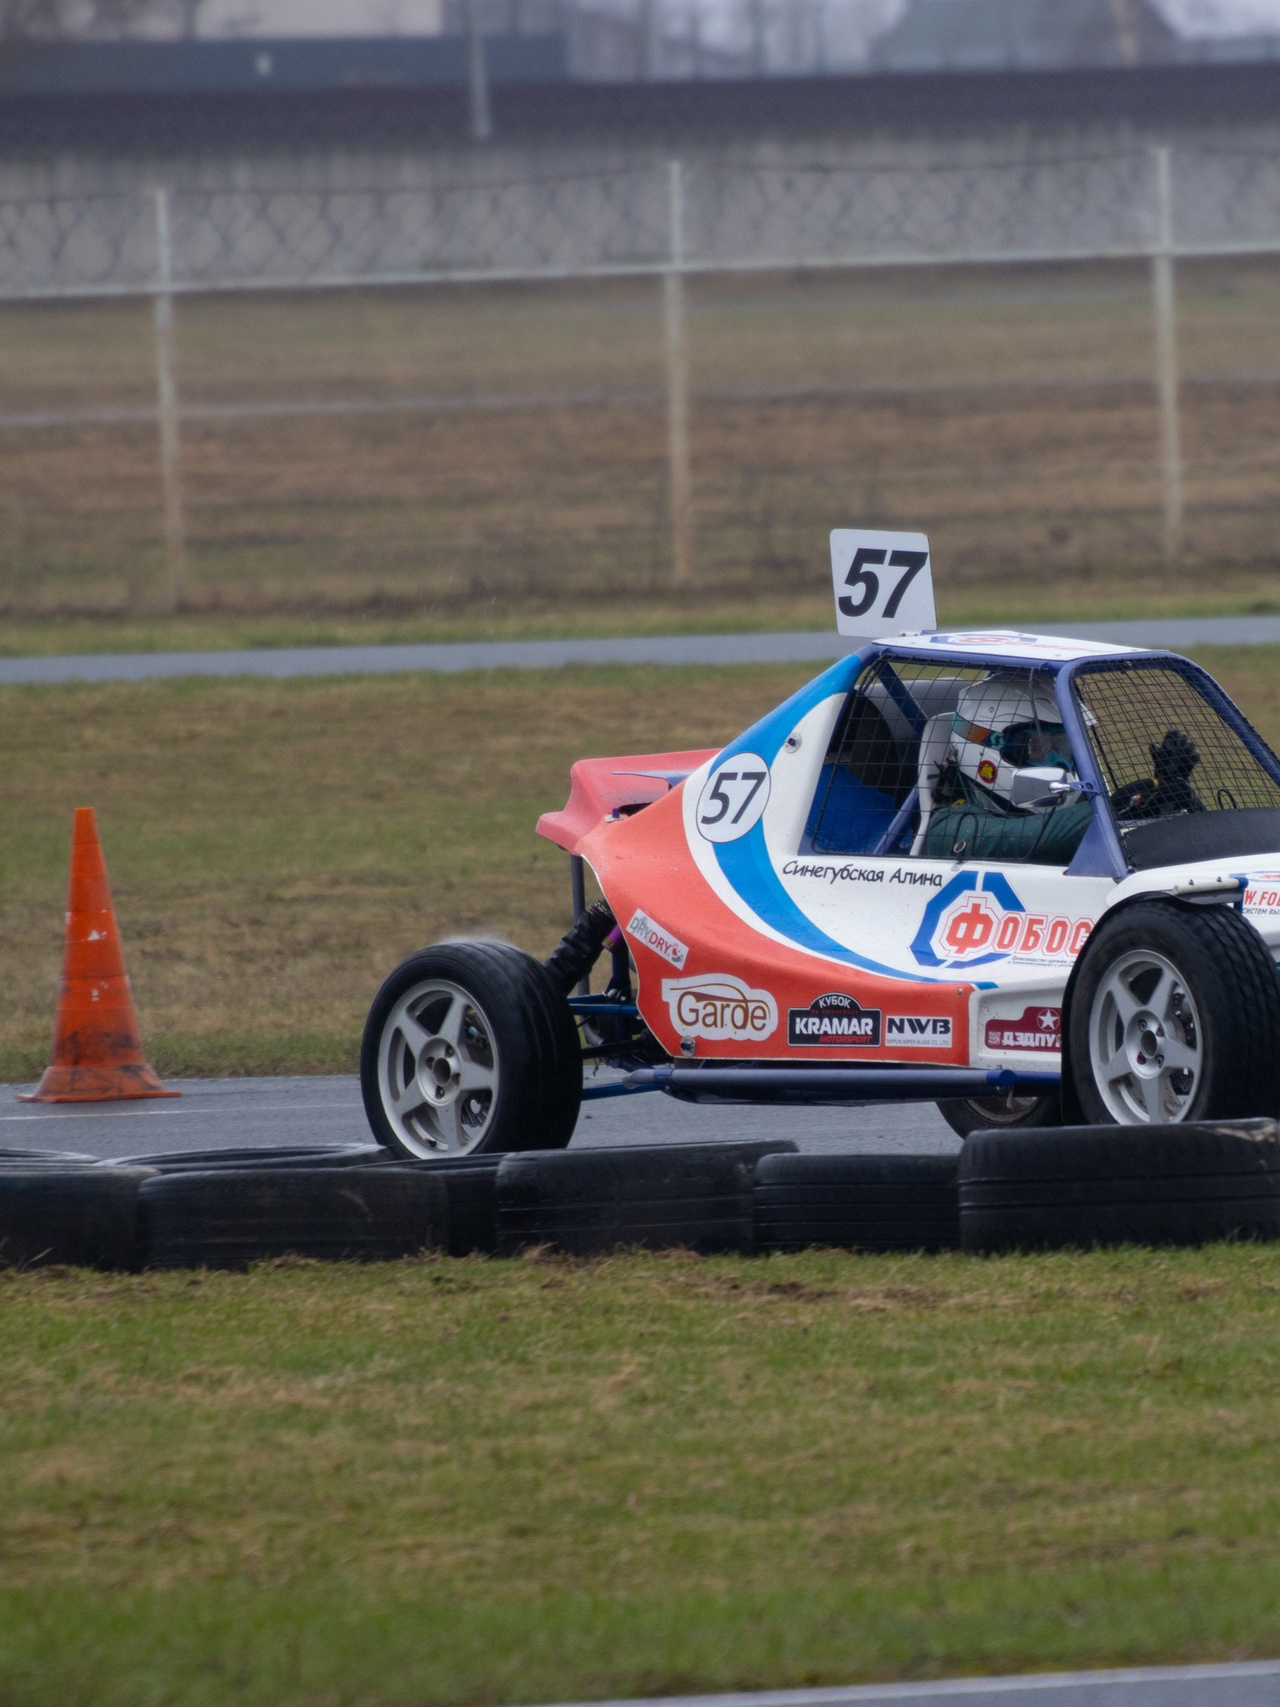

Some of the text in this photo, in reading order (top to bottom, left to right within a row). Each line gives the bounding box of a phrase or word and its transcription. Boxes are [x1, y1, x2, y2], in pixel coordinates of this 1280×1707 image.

[838, 548, 929, 618] 57
[701, 771, 767, 825] 57
[783, 860, 944, 887] Синегубская Алина
[942, 900, 1094, 956] ФОБОС
[677, 988, 769, 1031] Garde
[818, 996, 852, 1010] КУБОК
[795, 1017, 874, 1035] KRAMAR
[818, 1035, 874, 1044] MOTORSPORT
[887, 1018, 951, 1035] NWB
